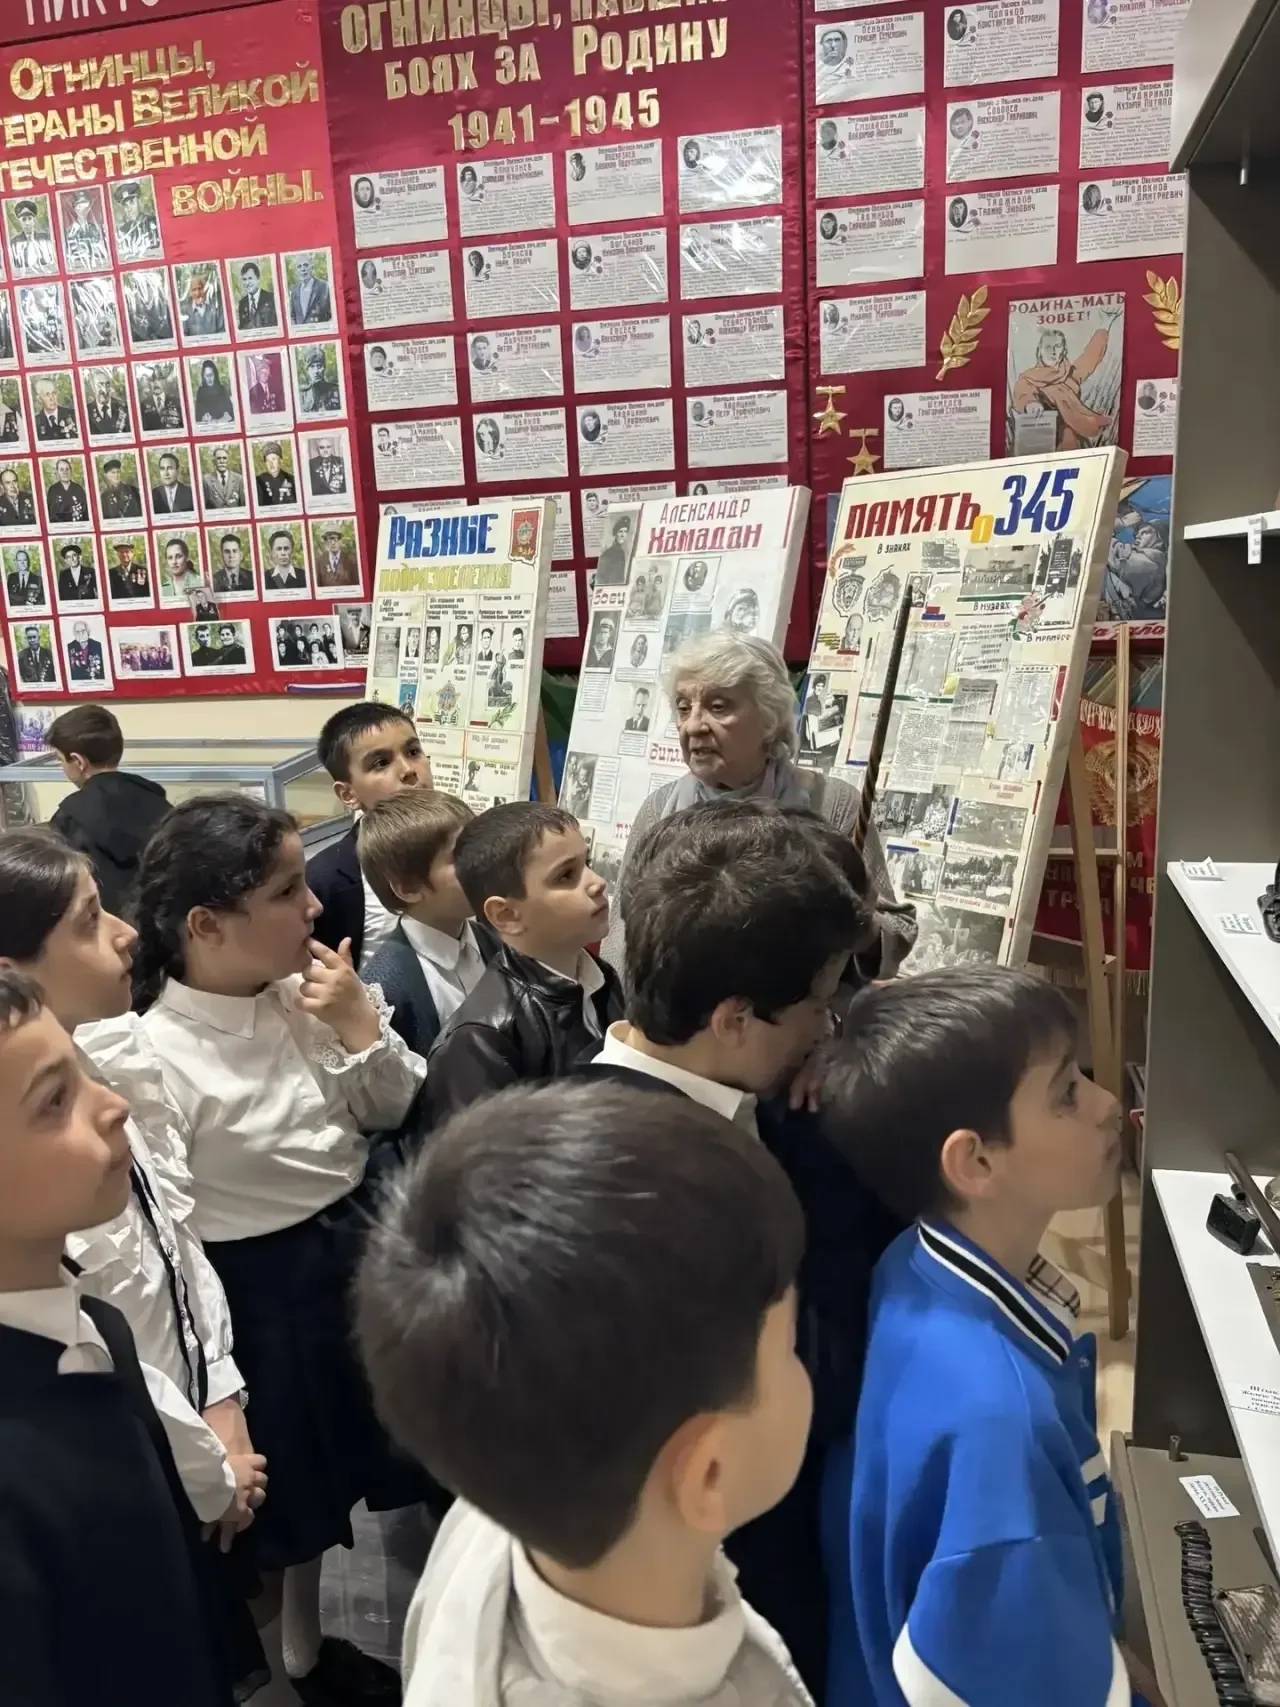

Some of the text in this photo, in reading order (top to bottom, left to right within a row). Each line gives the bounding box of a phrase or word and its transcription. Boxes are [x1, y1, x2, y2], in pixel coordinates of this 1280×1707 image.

[385, 50, 478, 100] БОЯХ
[495, 43, 541, 84] ЗА
[1036, 311, 1091, 325] ЗОВЕТ!
[844, 492, 981, 540] ПАМЯТЬ
[993, 468, 1080, 535] 345
